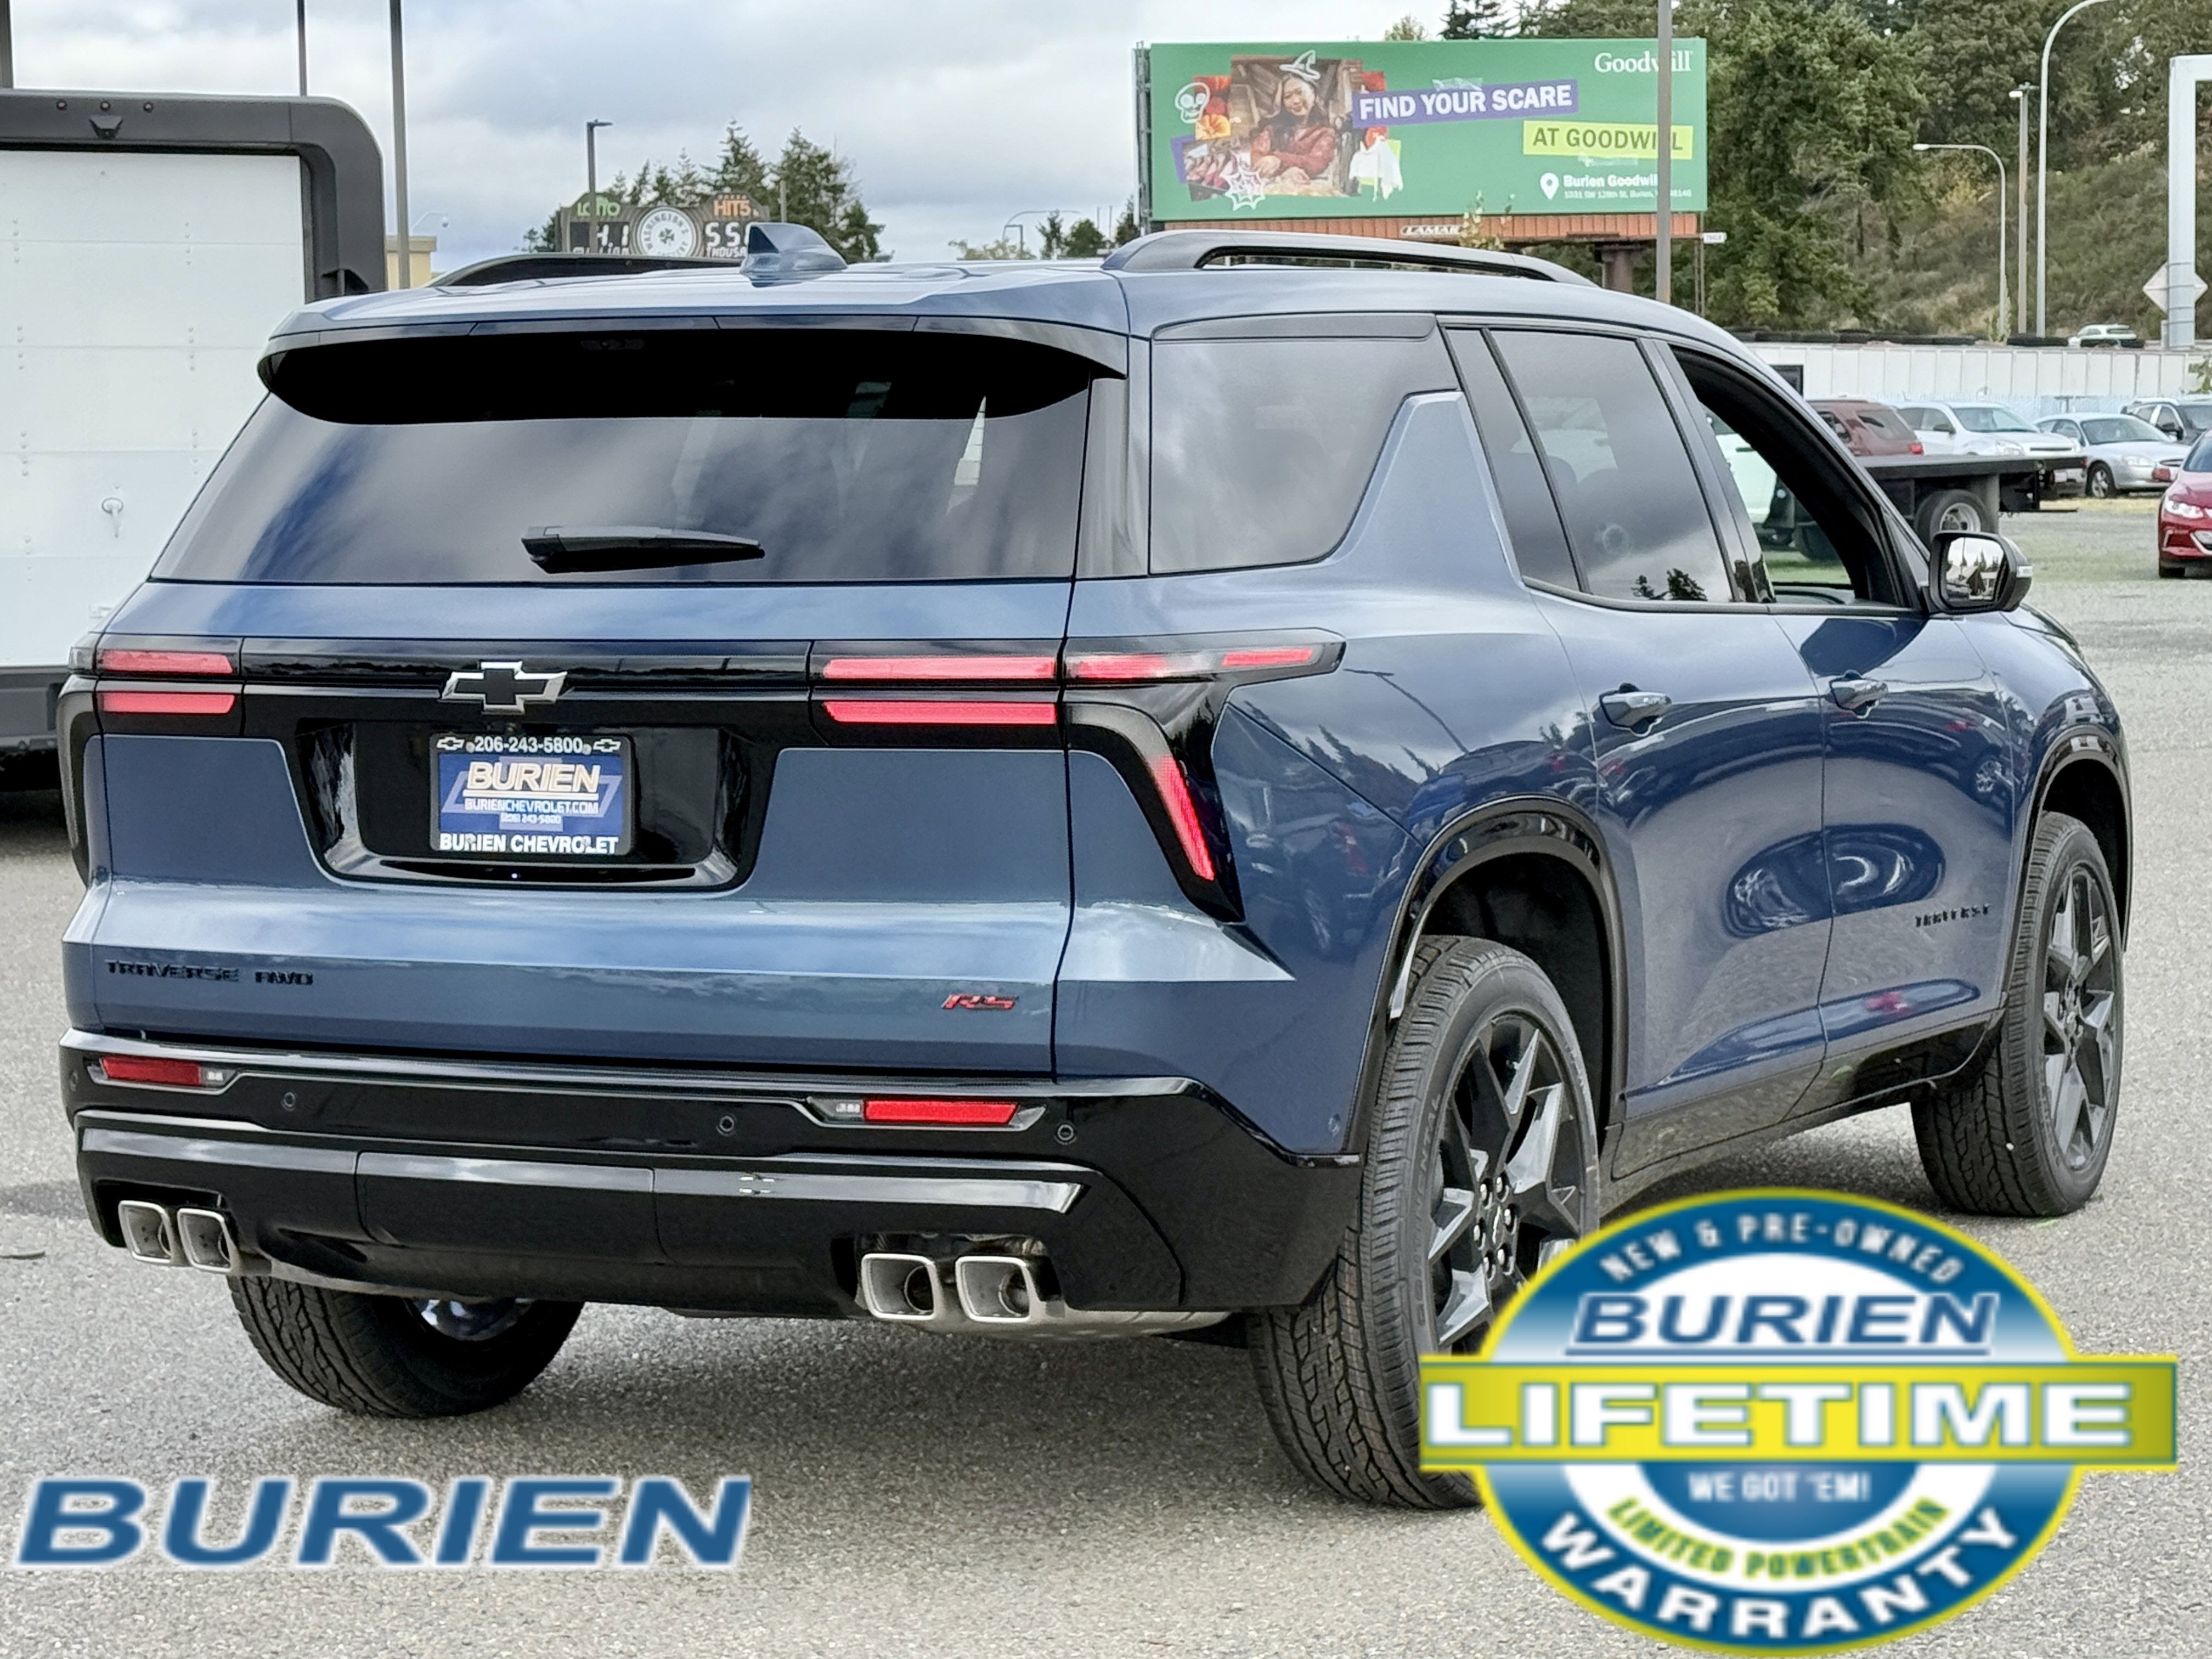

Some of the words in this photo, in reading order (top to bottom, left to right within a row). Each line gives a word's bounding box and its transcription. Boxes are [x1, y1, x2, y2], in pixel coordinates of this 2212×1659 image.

[1359, 95, 1417, 120] FIND
[1420, 90, 1487, 116] YOUR
[1491, 84, 1573, 111] SCARE
[1533, 127, 1559, 146] AT
[1566, 128, 1683, 151] GOODWIL
[1563, 174, 1605, 187] Burien
[1607, 173, 1658, 187] Goodwil
[705, 222, 748, 247] 55
[474, 736, 583, 753] 206-243-5800
[466, 760, 601, 793] BURIEN
[464, 798, 599, 815] BURIENCHEVROLET.COM
[439, 833, 507, 853] BURIEN
[511, 835, 619, 855] CHEVROLET
[104, 959, 240, 983] TRAVERSE
[255, 969, 314, 985] AWD
[940, 992, 1018, 1010] RS
